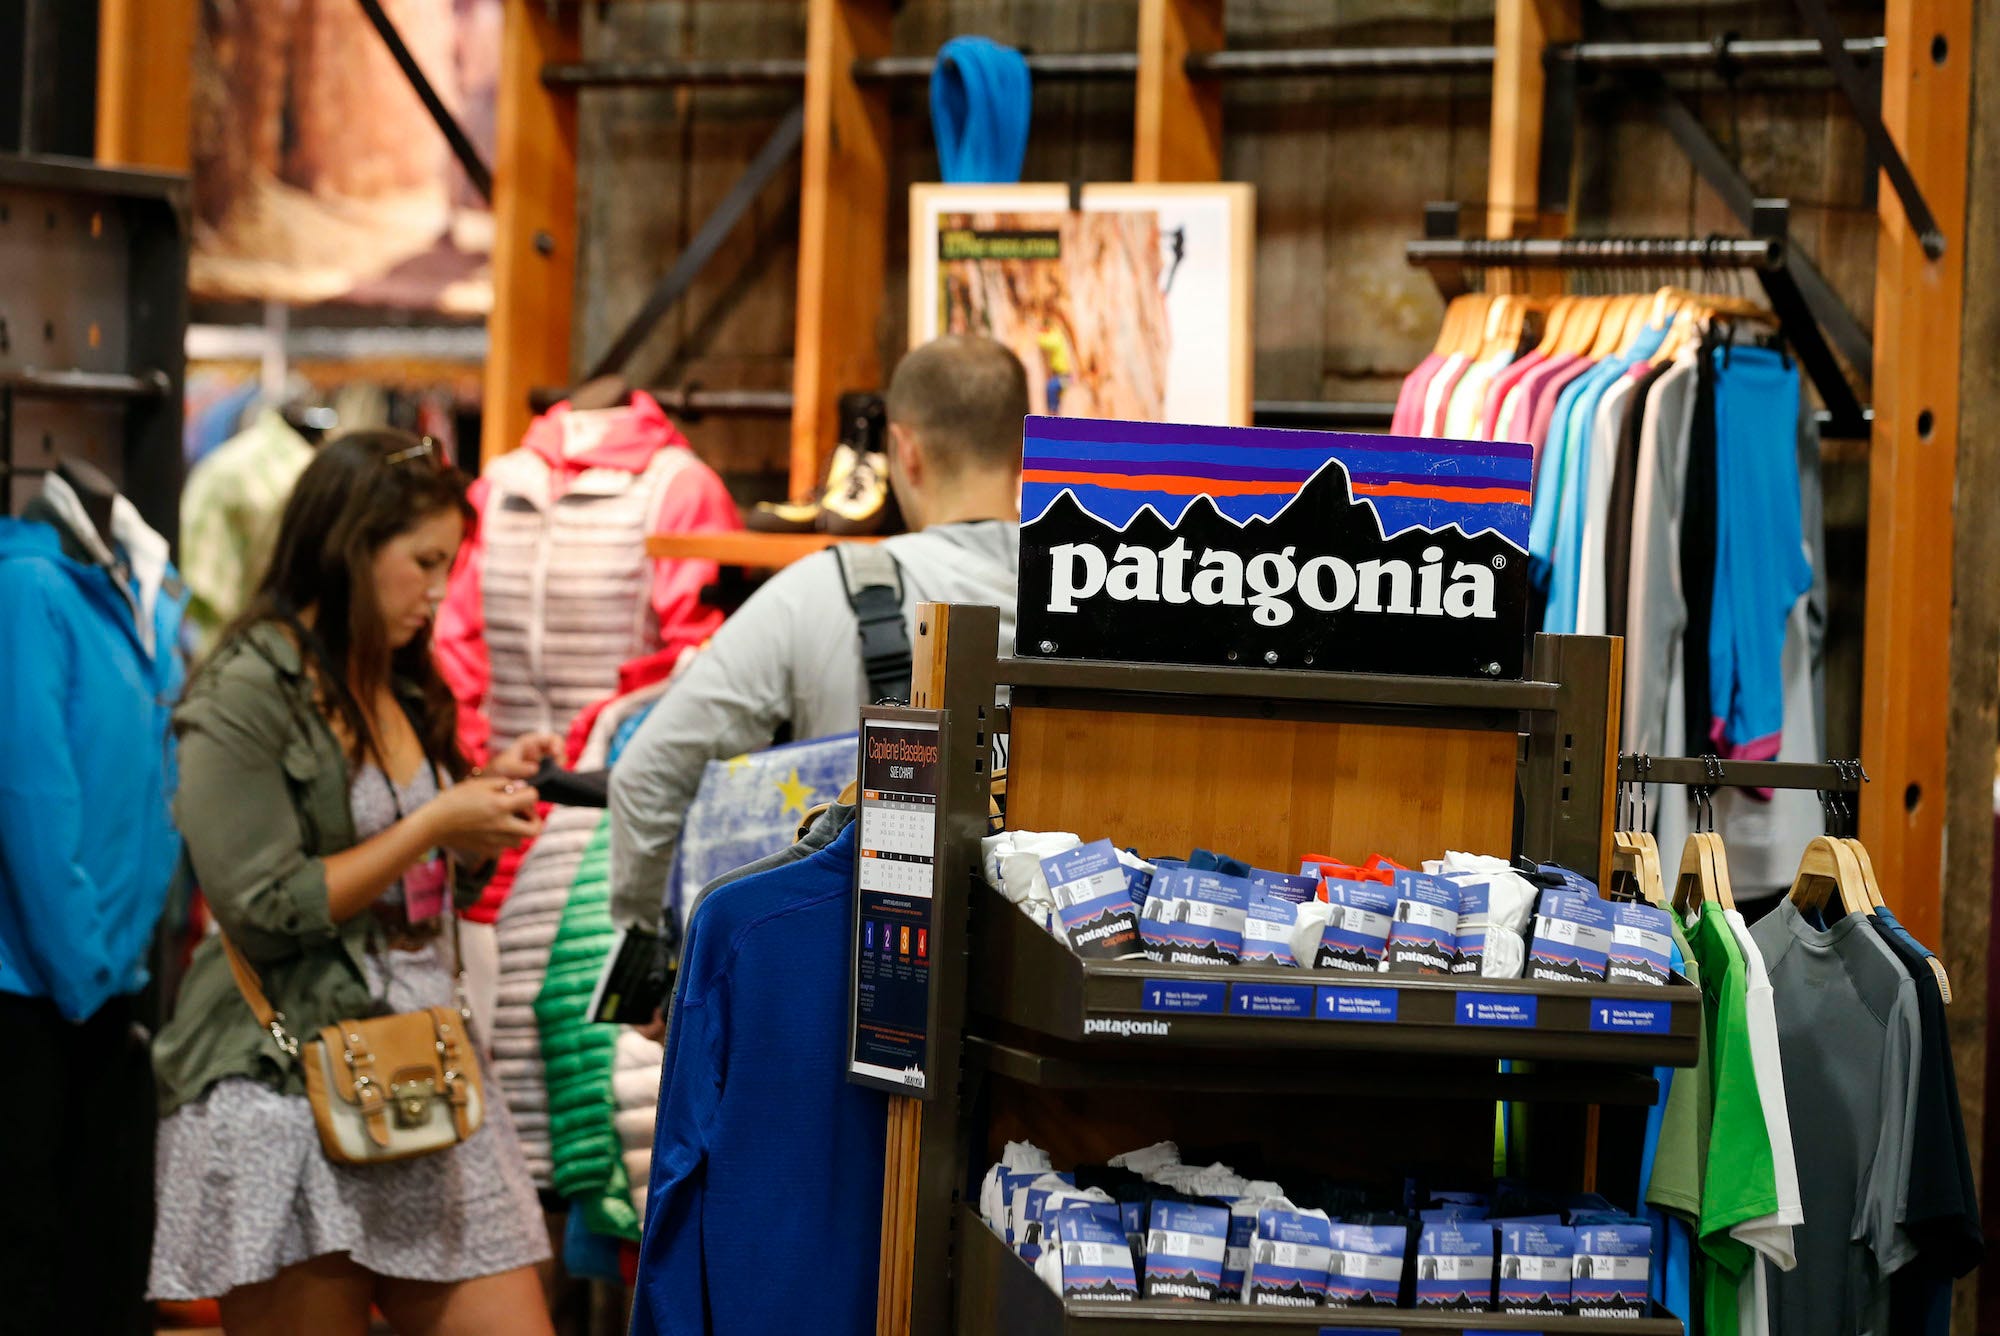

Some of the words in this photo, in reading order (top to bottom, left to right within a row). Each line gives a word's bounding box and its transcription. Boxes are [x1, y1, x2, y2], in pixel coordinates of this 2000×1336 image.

[868, 736, 899, 764] Capilene
[900, 738, 938, 768] Baselayers
[890, 765, 899, 778] SIZE
[899, 766, 914, 779] CHART
[1049, 862, 1064, 882] 1
[1158, 875, 1170, 896] 1
[1183, 876, 1195, 897] 1
[1333, 884, 1345, 903] 1
[1401, 876, 1411, 897] 1
[1547, 895, 1559, 915] 1
[868, 927, 872, 945] 1
[885, 929, 891, 948] 2
[902, 932, 908, 950] 3
[919, 935, 925, 953] 4
[1076, 919, 1132, 947] patagonia
[1396, 951, 1449, 970] patagonia
[1532, 967, 1591, 982] patagon
[1610, 966, 1664, 986] patagonia
[1153, 991, 1161, 1005] 1
[1240, 995, 1248, 1010] 1
[1326, 996, 1334, 1012] 1
[1465, 1003, 1474, 1019] 1
[1600, 1009, 1609, 1025] 1
[1083, 1018, 1169, 1037] patagonia
[1032, 1198, 1043, 1219] 1
[1157, 1207, 1169, 1229] 1
[1128, 1208, 1139, 1230] 1
[1265, 1216, 1276, 1239] 1
[1066, 1220, 1078, 1240] 1
[1333, 1229, 1345, 1250] 1
[1424, 1231, 1436, 1253] 1
[1508, 1230, 1520, 1252] 1
[1581, 1231, 1592, 1253] 1
[1151, 1282, 1211, 1300] patagonia
[1257, 1292, 1316, 1308] patagonia
[1579, 1306, 1641, 1319] patagonia
